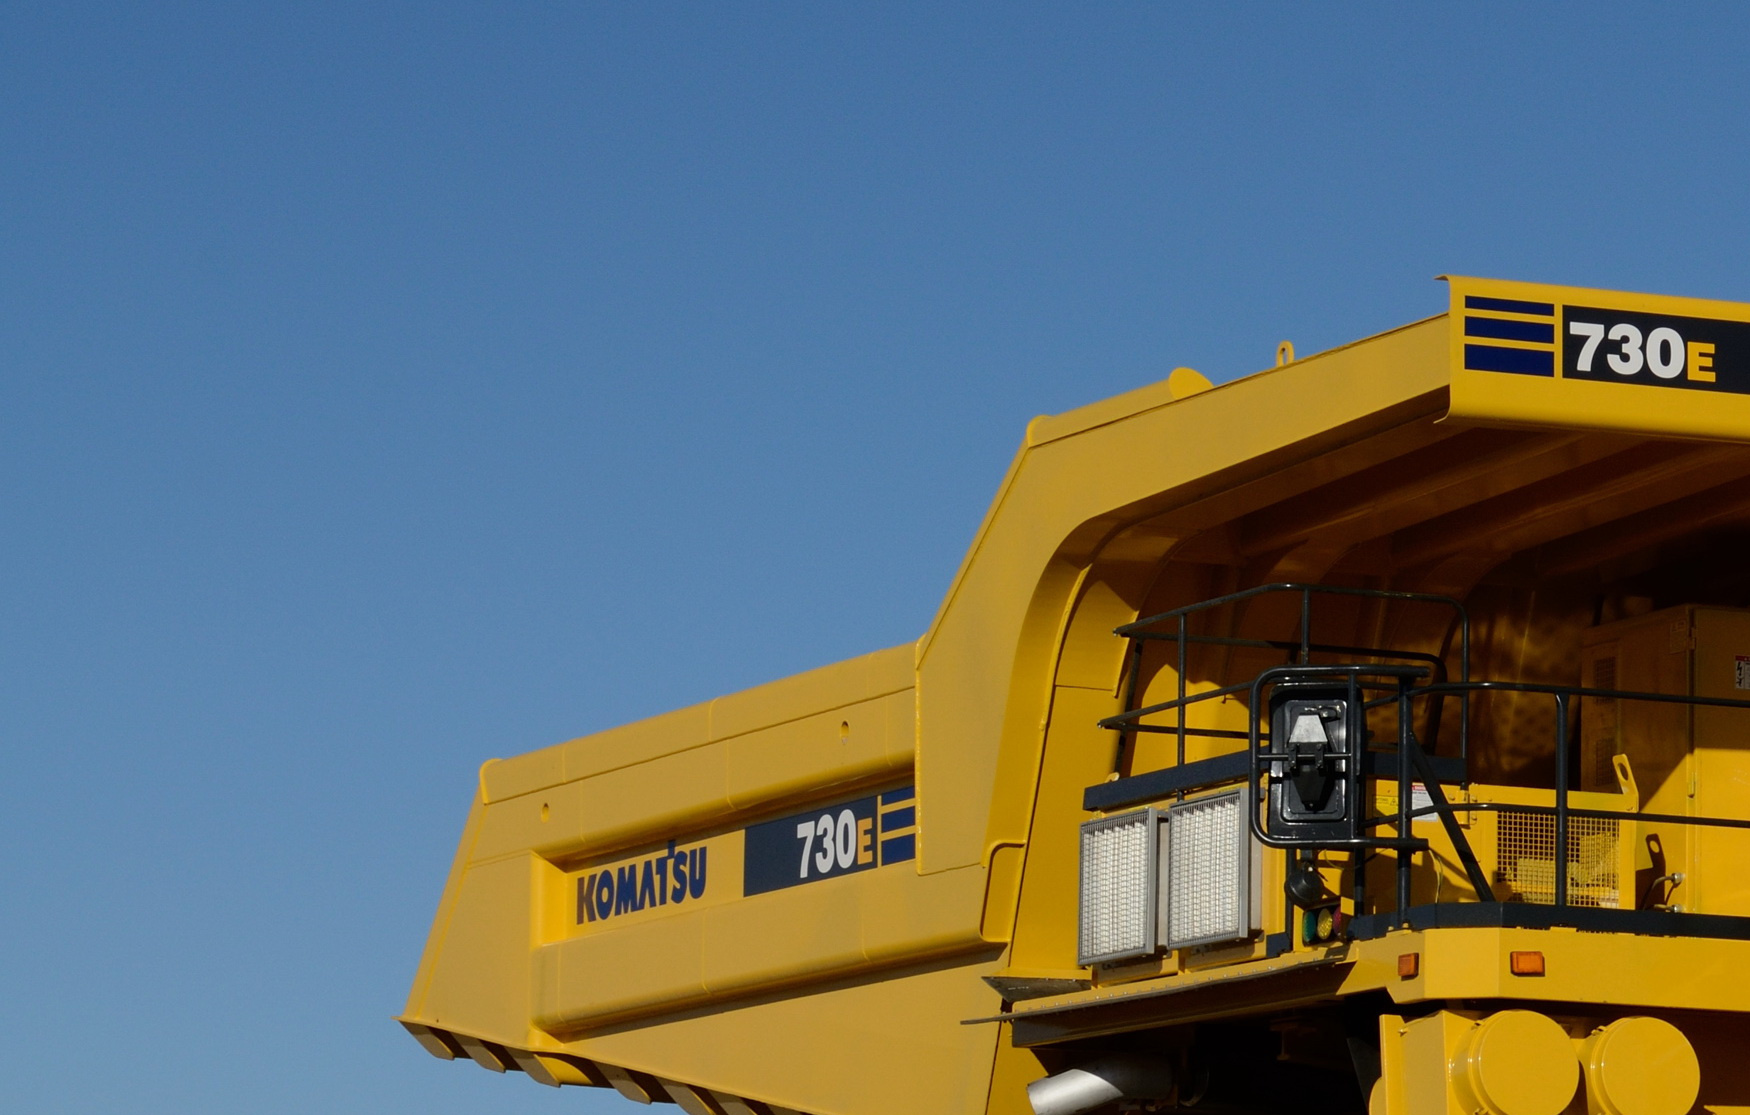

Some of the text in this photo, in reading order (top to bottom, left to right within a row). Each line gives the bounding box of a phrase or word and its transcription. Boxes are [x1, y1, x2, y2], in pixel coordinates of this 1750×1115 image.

[1569, 321, 1716, 383] 730E
[796, 807, 874, 879] 730E
[576, 839, 707, 925] KOMATSU
